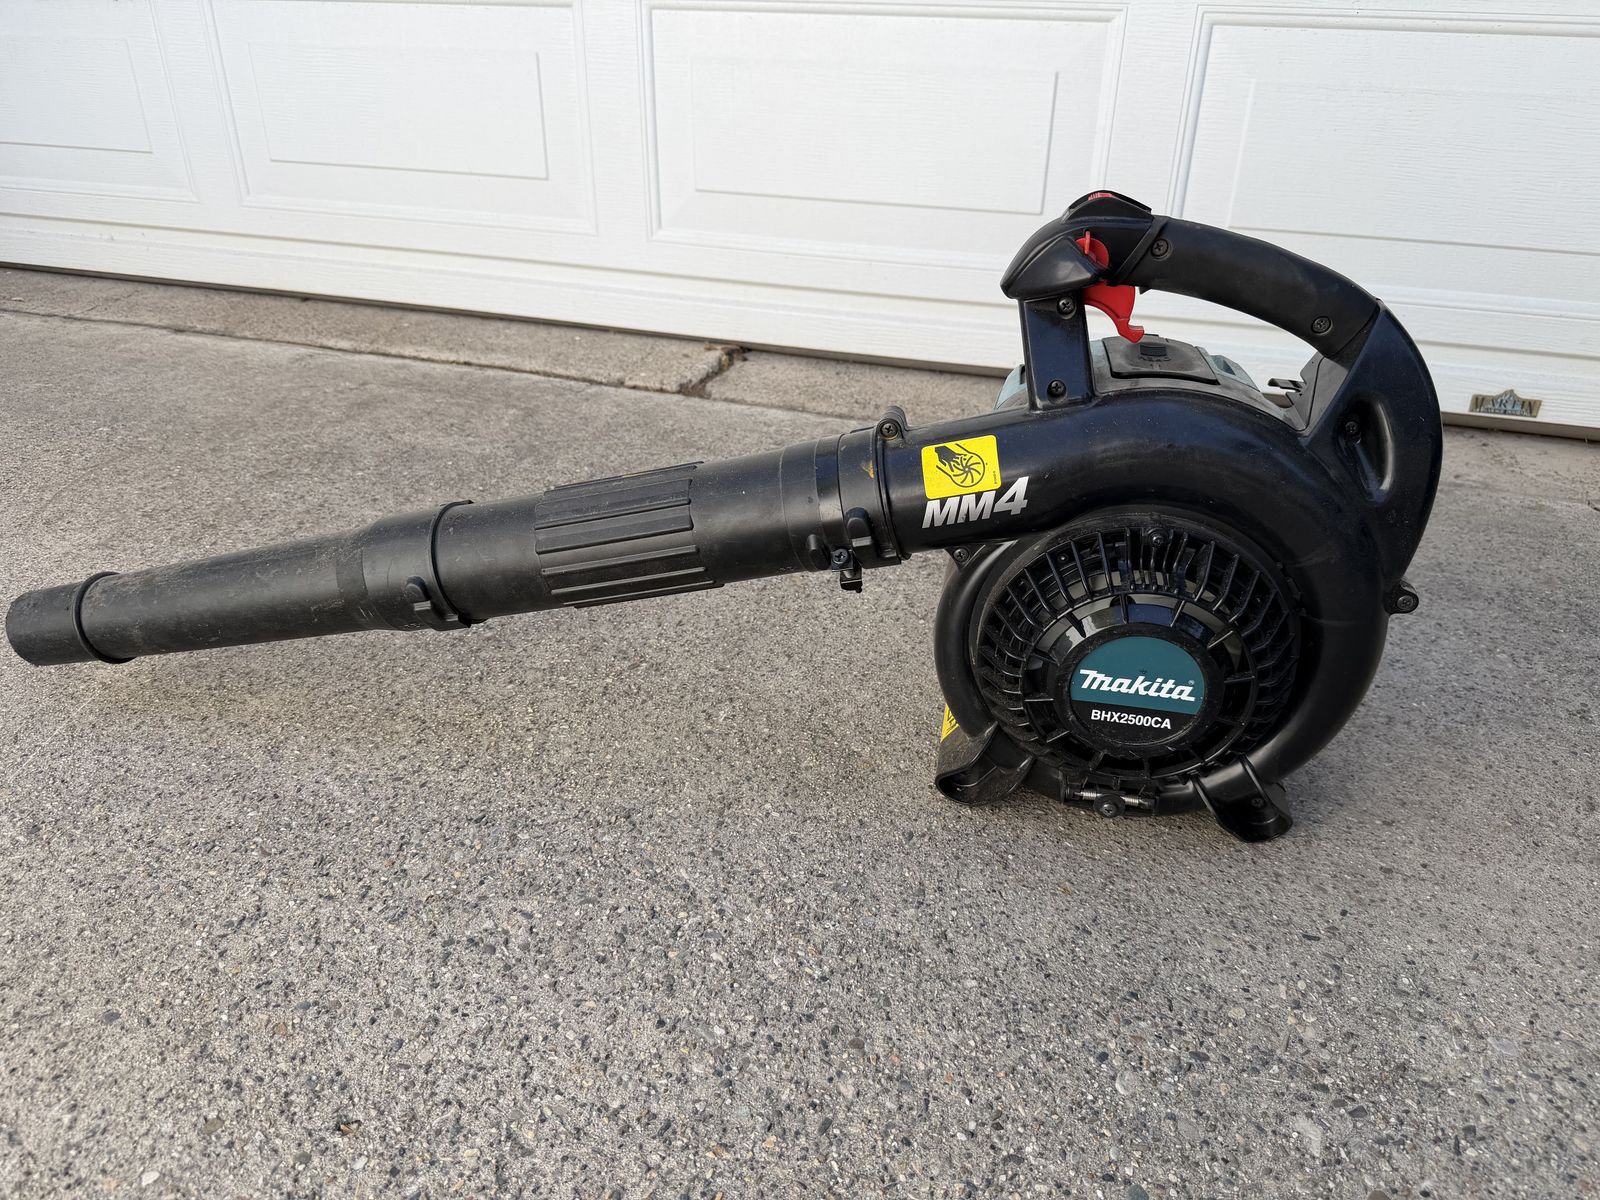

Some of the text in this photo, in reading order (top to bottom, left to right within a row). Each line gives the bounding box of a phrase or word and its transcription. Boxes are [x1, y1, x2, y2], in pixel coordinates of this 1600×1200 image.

[922, 476, 1030, 529] MM4
[1080, 669, 1196, 702] Makita
[1091, 709, 1172, 730] BHX2500CA
